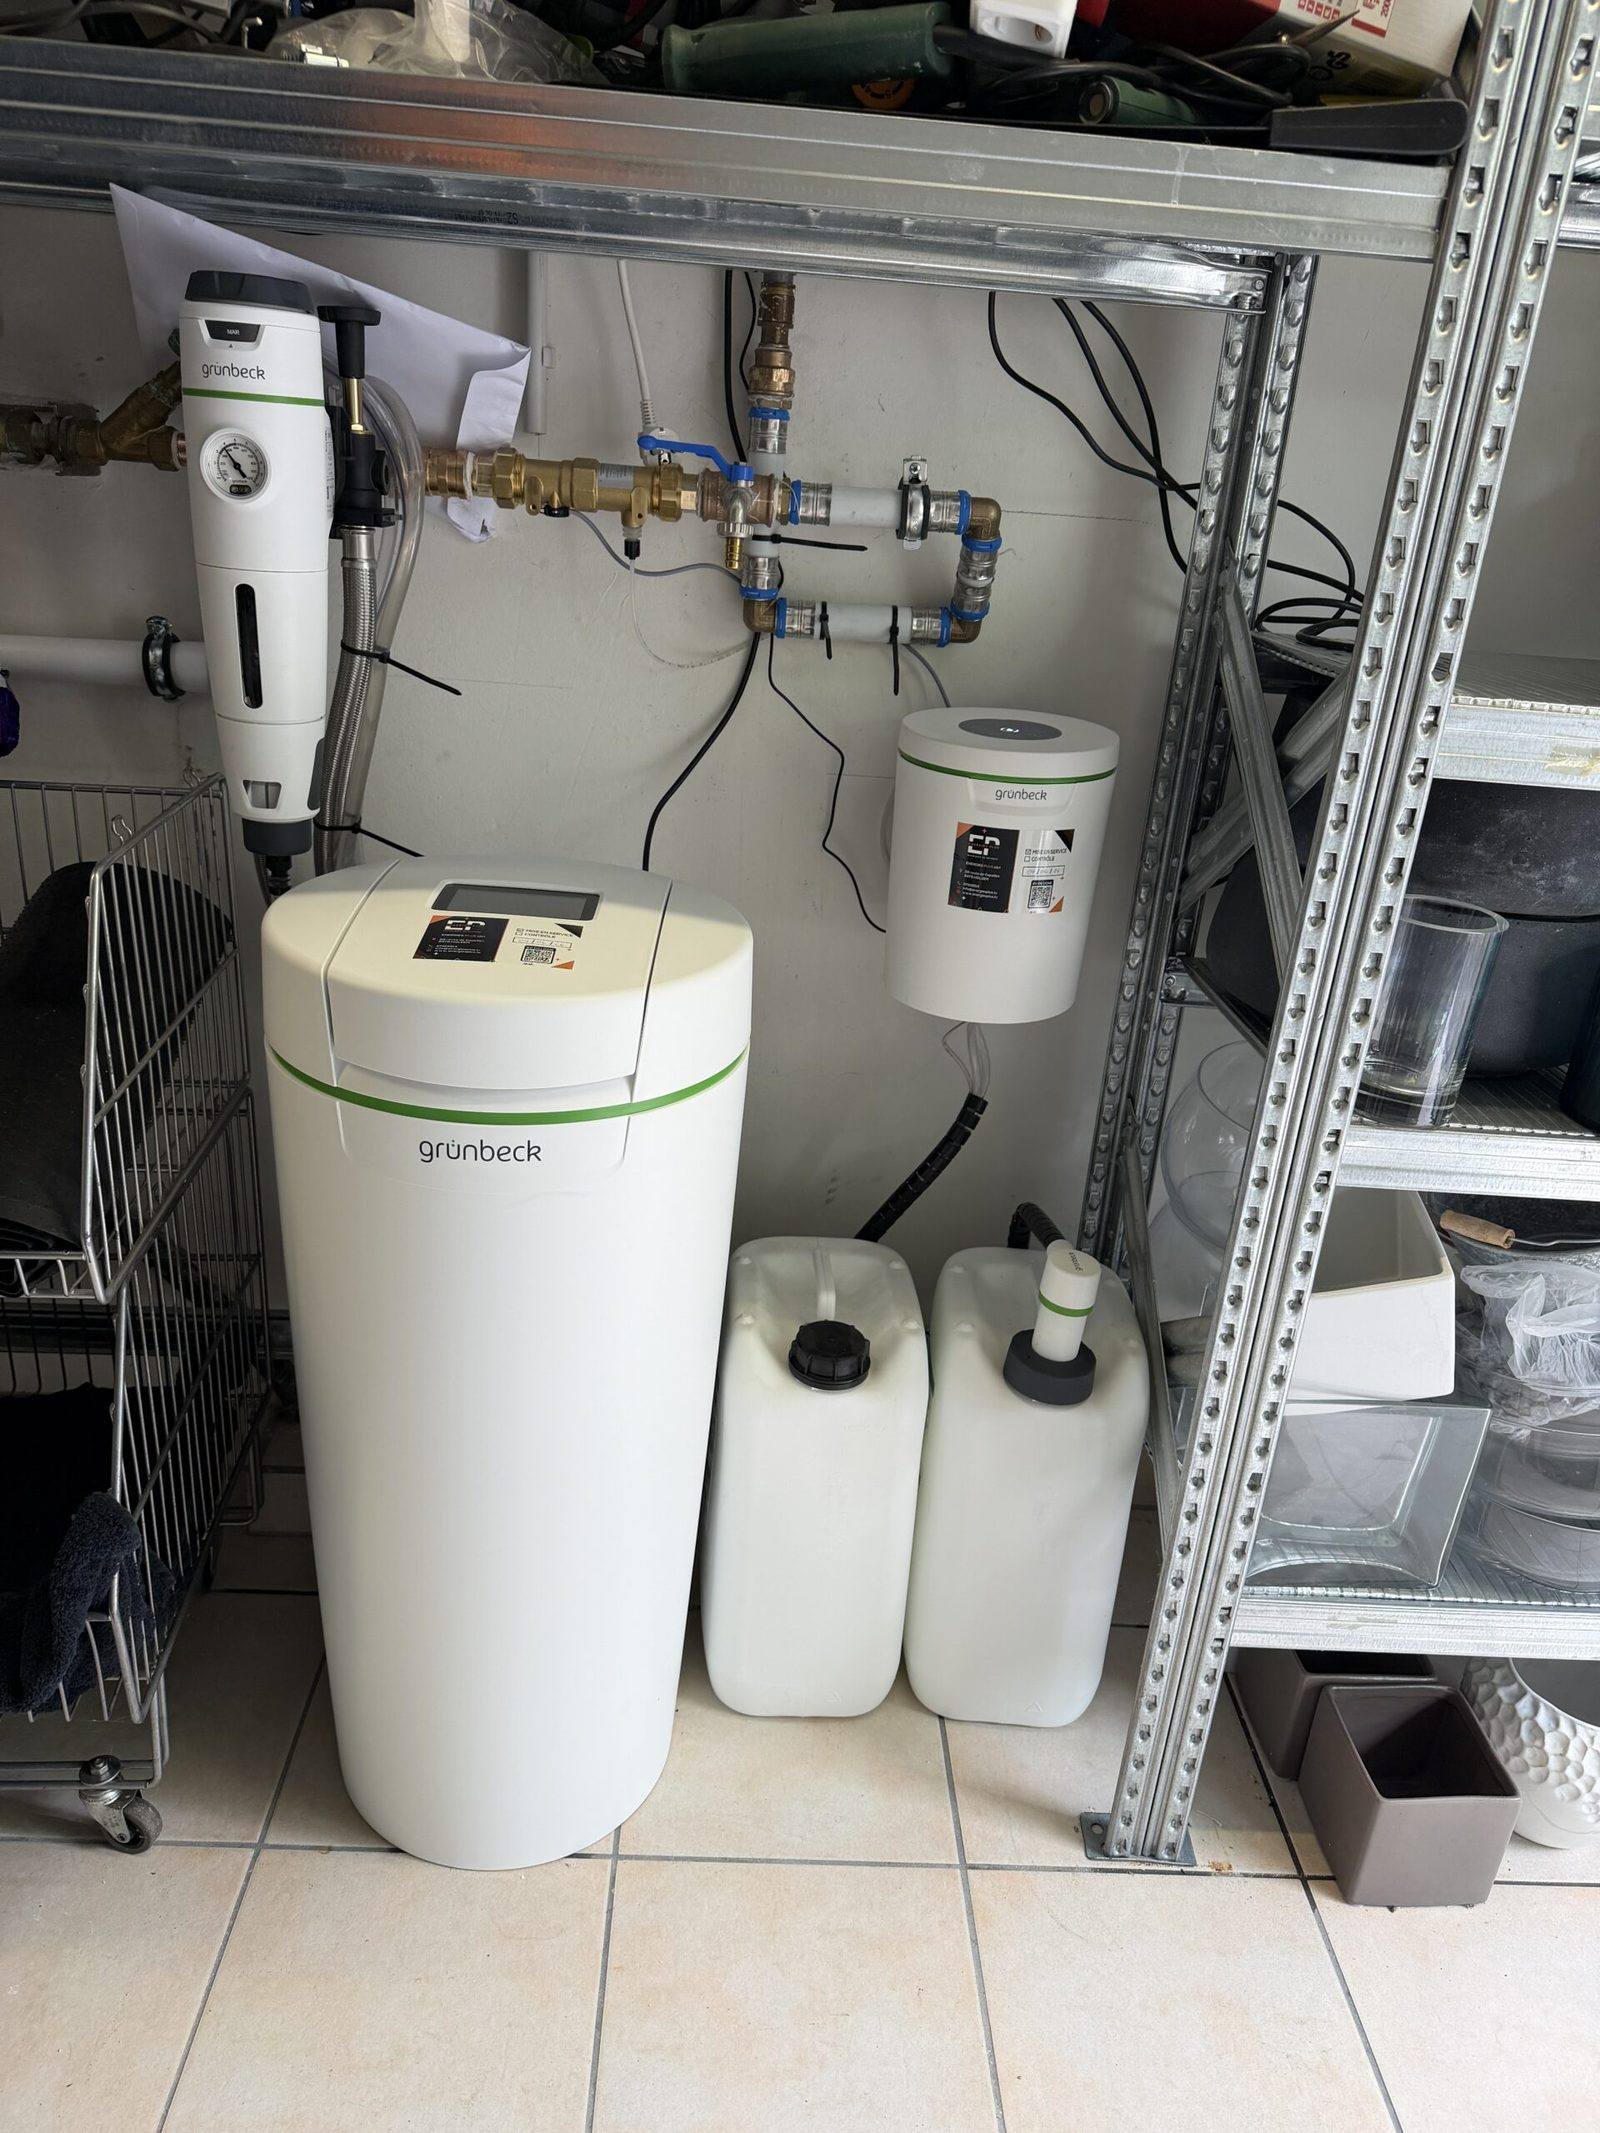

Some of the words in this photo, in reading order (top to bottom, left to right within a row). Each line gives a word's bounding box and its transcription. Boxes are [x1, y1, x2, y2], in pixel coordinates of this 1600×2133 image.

[201, 361, 266, 380] grünbeck
[995, 788, 1048, 801] grünbeck
[419, 1139, 542, 1163] grünbeck
